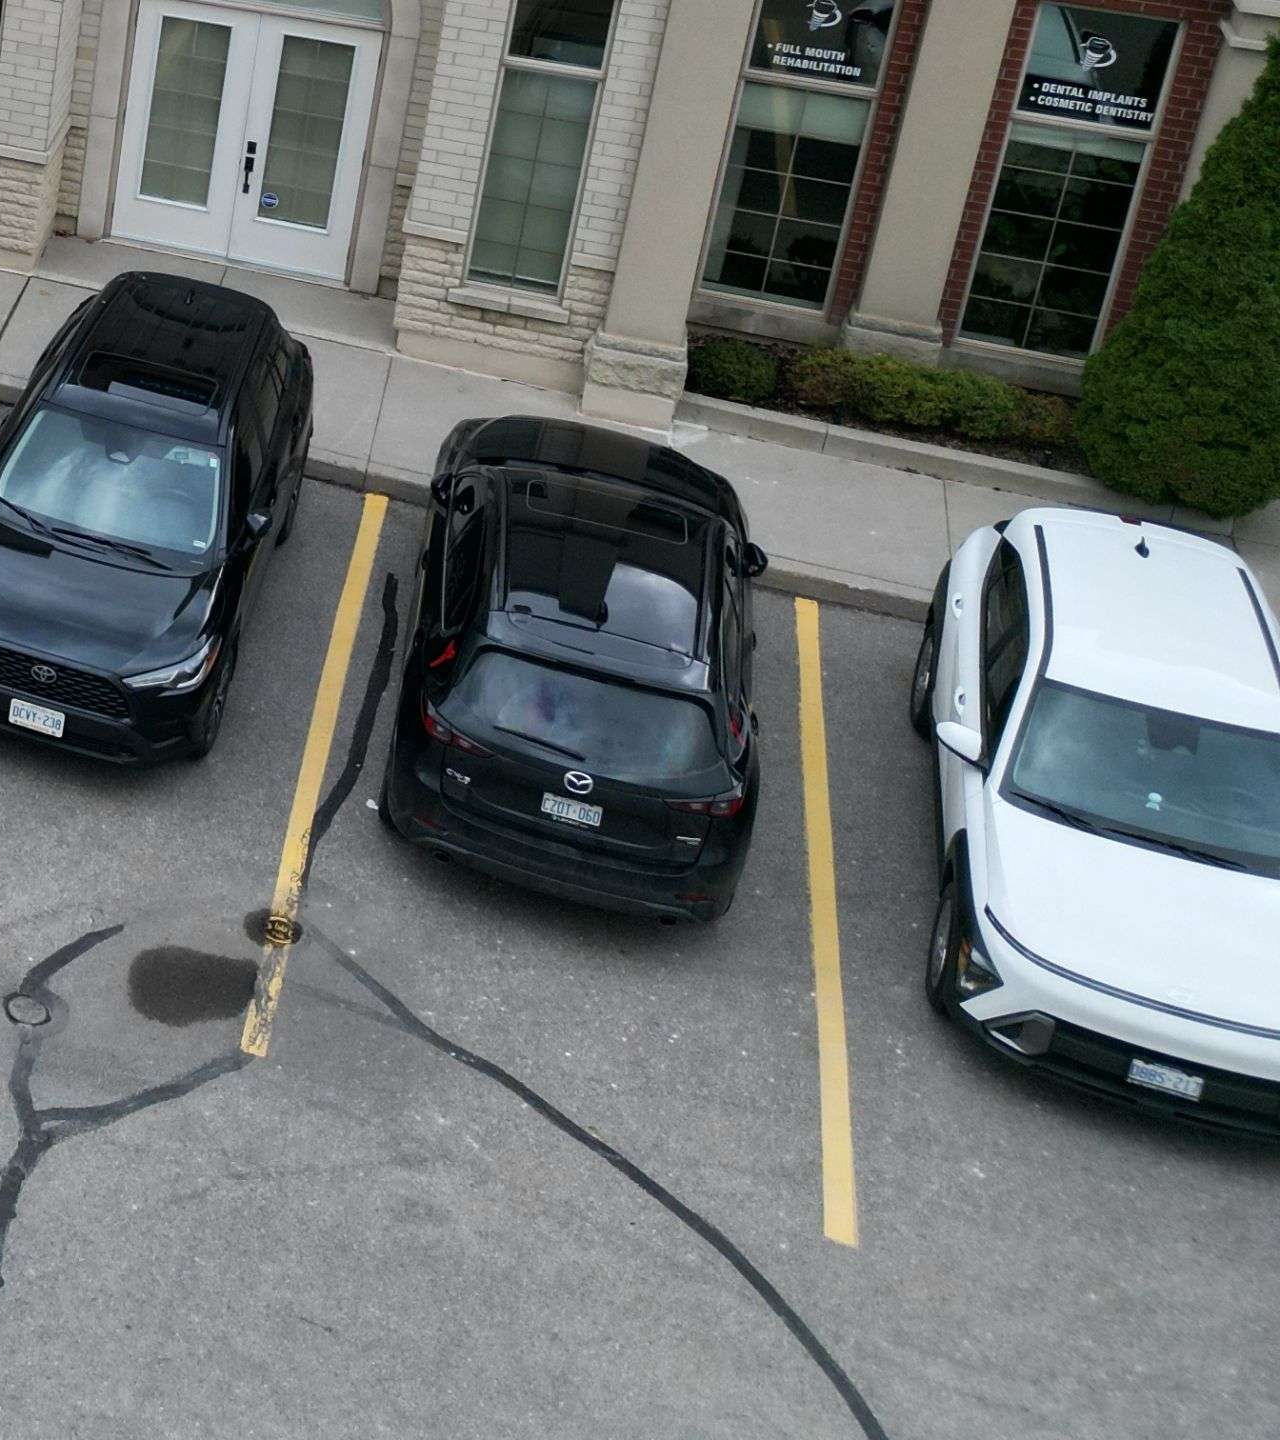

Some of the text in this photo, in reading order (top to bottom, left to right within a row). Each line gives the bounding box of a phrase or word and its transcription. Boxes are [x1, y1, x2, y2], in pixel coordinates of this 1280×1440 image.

[775, 42, 846, 61] FULL MOUTH
[772, 54, 862, 77] REHABILITATION
[1041, 82, 1149, 108] DENTAL IMPLANTS
[1037, 95, 1155, 123] COSMETIC DENTISTRY
